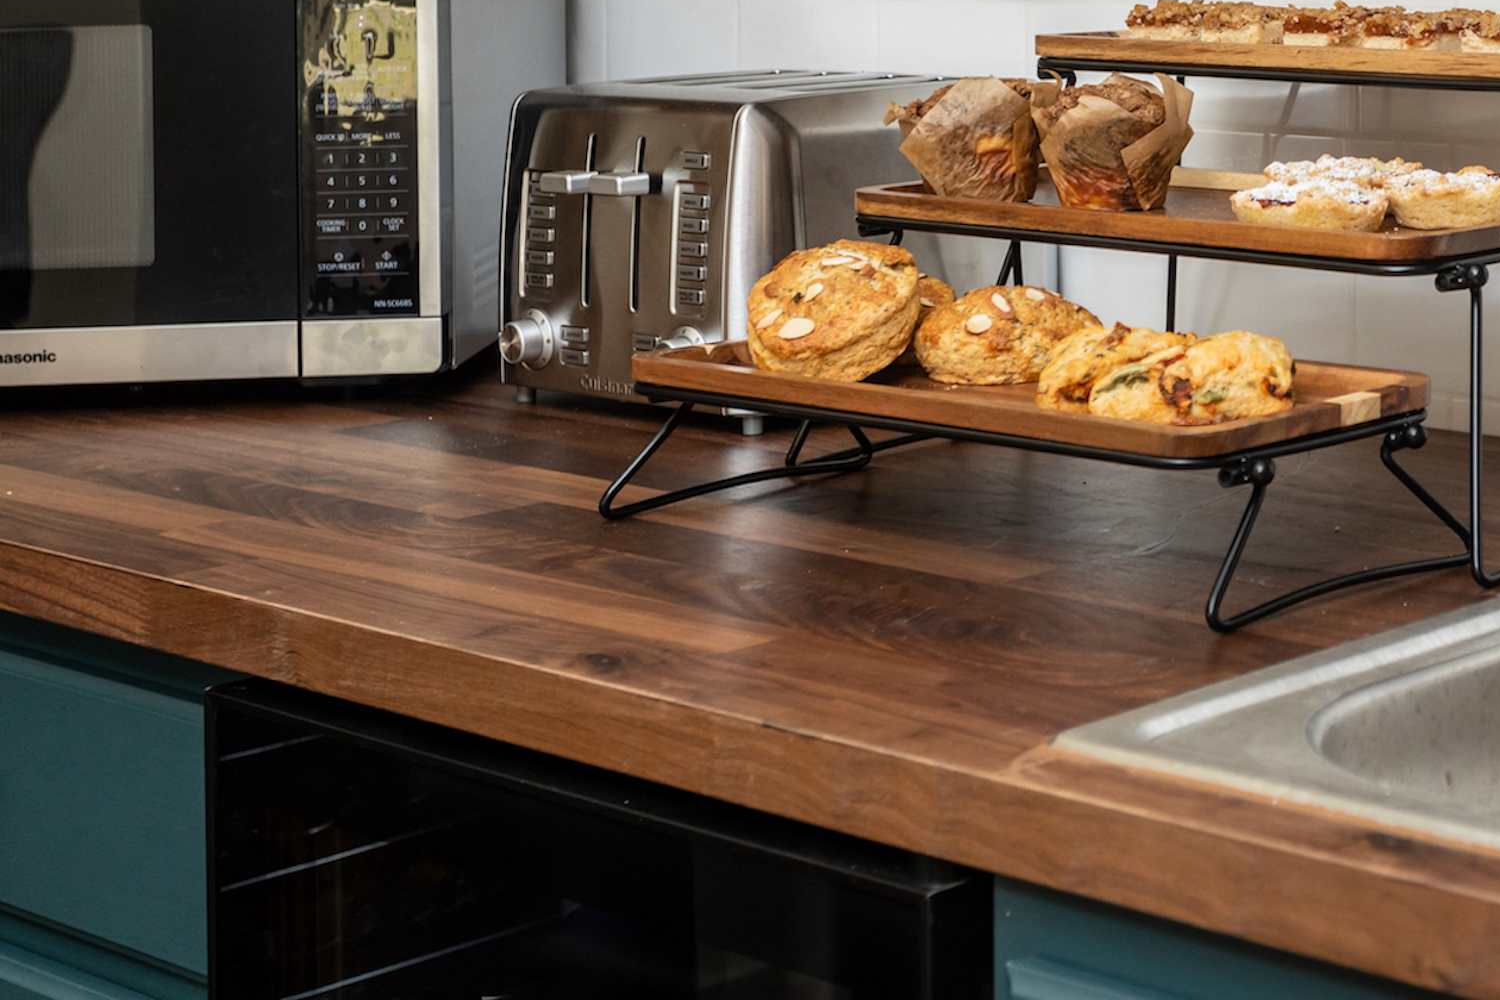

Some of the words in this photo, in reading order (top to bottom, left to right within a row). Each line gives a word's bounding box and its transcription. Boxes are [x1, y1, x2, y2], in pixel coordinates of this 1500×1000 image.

[385, 131, 401, 140] LESS
[358, 153, 366, 164] 2
[389, 151, 397, 163] 3
[326, 176, 335, 187] 4
[358, 175, 366, 186] 5
[389, 175, 397, 186] 6
[327, 198, 336, 209] 7
[358, 198, 367, 209] 8
[389, 197, 398, 208] 9
[358, 220, 367, 231] 0
[317, 262, 361, 272] STOP/RESET
[375, 260, 399, 271] START
